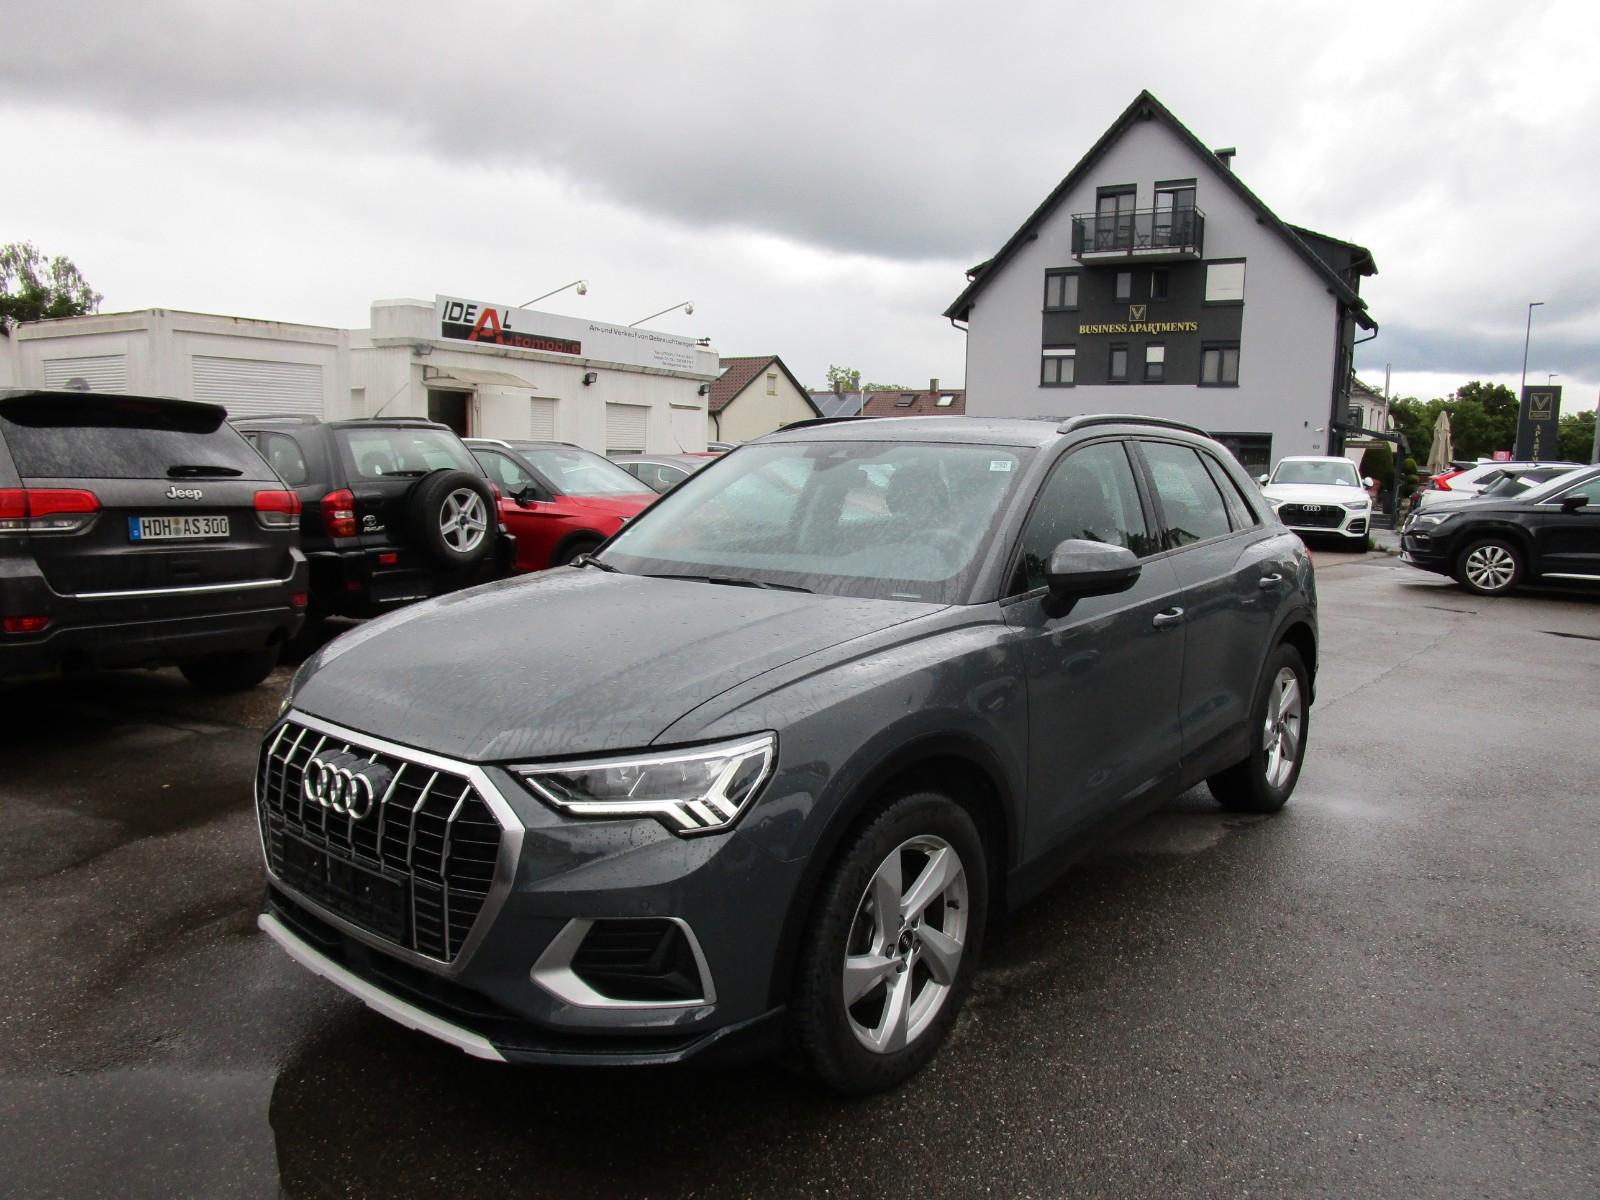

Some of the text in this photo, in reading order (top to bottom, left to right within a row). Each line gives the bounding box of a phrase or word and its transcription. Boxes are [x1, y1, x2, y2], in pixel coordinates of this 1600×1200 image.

[442, 300, 512, 344] IDEAL
[1079, 321, 1198, 335] BUSINESS APARTMENTS
[613, 328, 637, 339] Verkauf
[167, 487, 203, 500] Jeep
[142, 518, 229, 537] HDH AS 300
